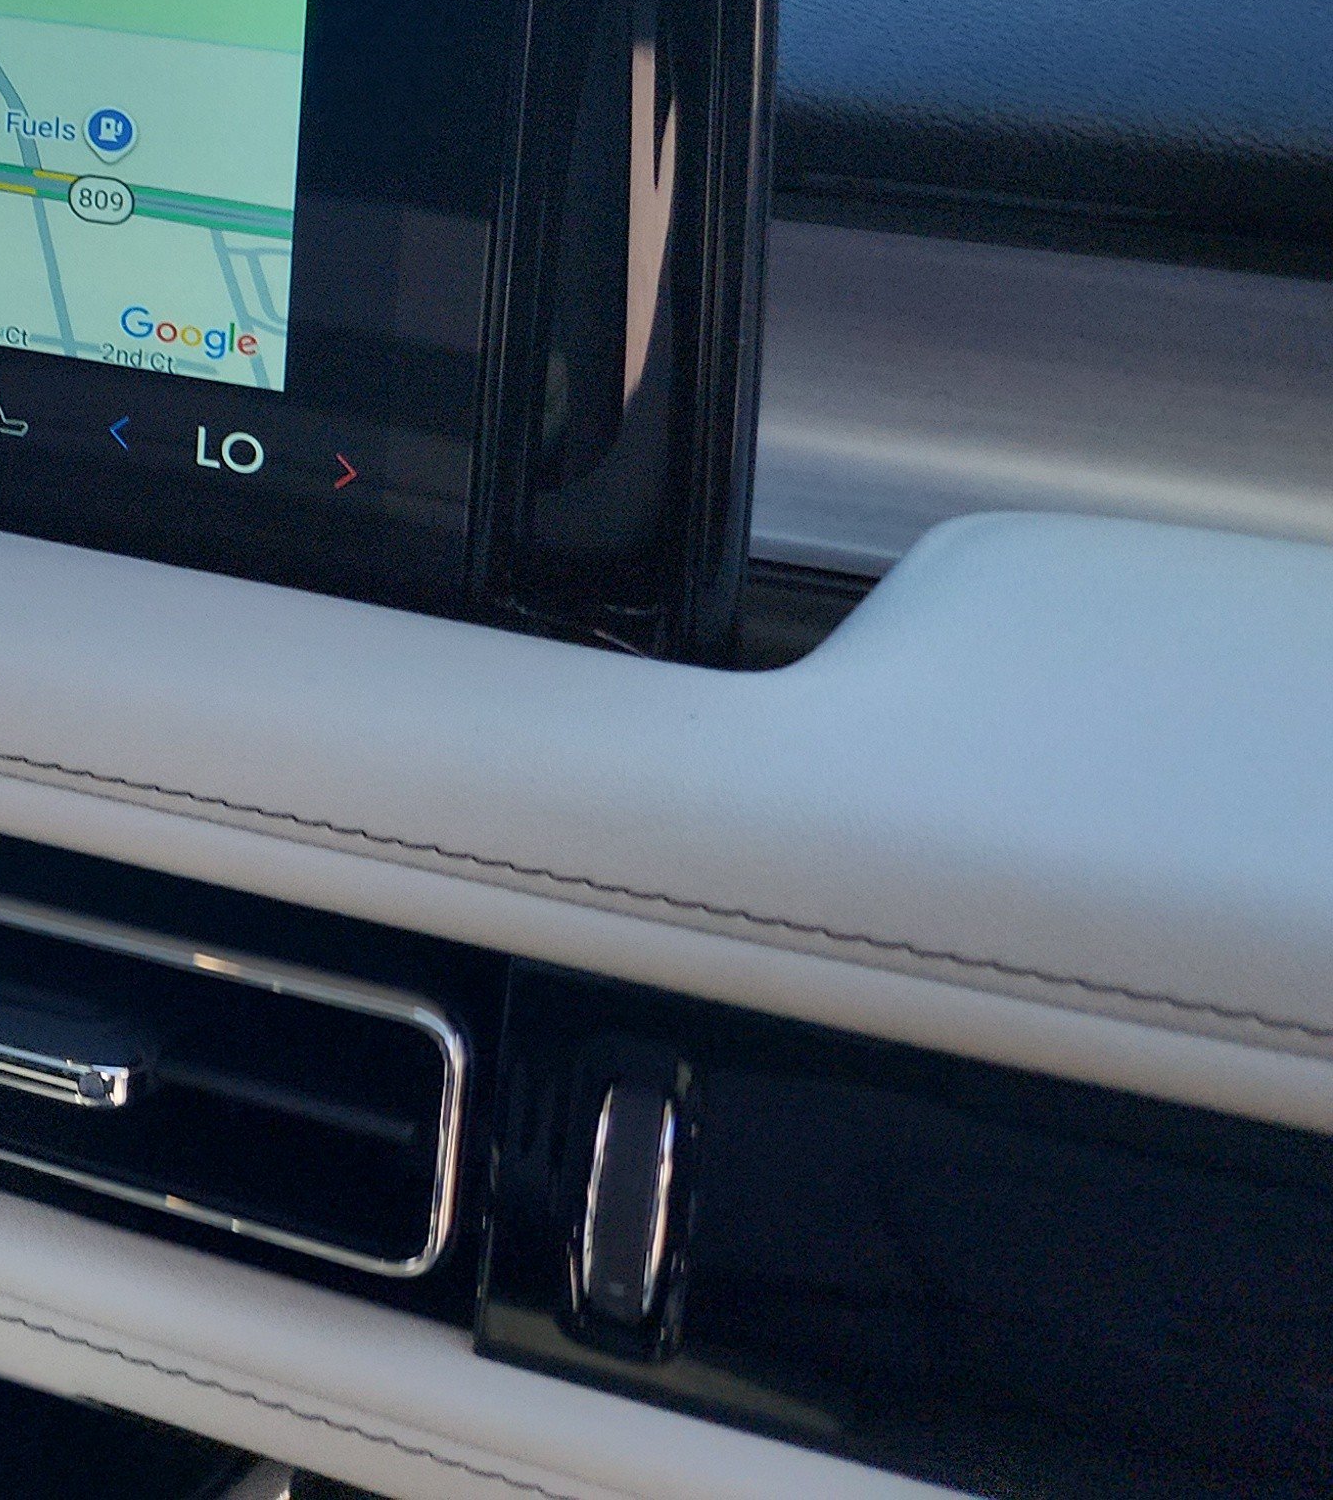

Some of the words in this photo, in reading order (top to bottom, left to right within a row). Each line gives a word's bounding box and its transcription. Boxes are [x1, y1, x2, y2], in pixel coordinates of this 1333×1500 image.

[5, 109, 77, 143] Fuels
[77, 186, 125, 214] 809
[3, 324, 30, 349] Ct
[119, 304, 259, 360] Google
[100, 342, 144, 369] 2nd
[148, 350, 175, 375] Ct
[195, 424, 265, 475] LO
